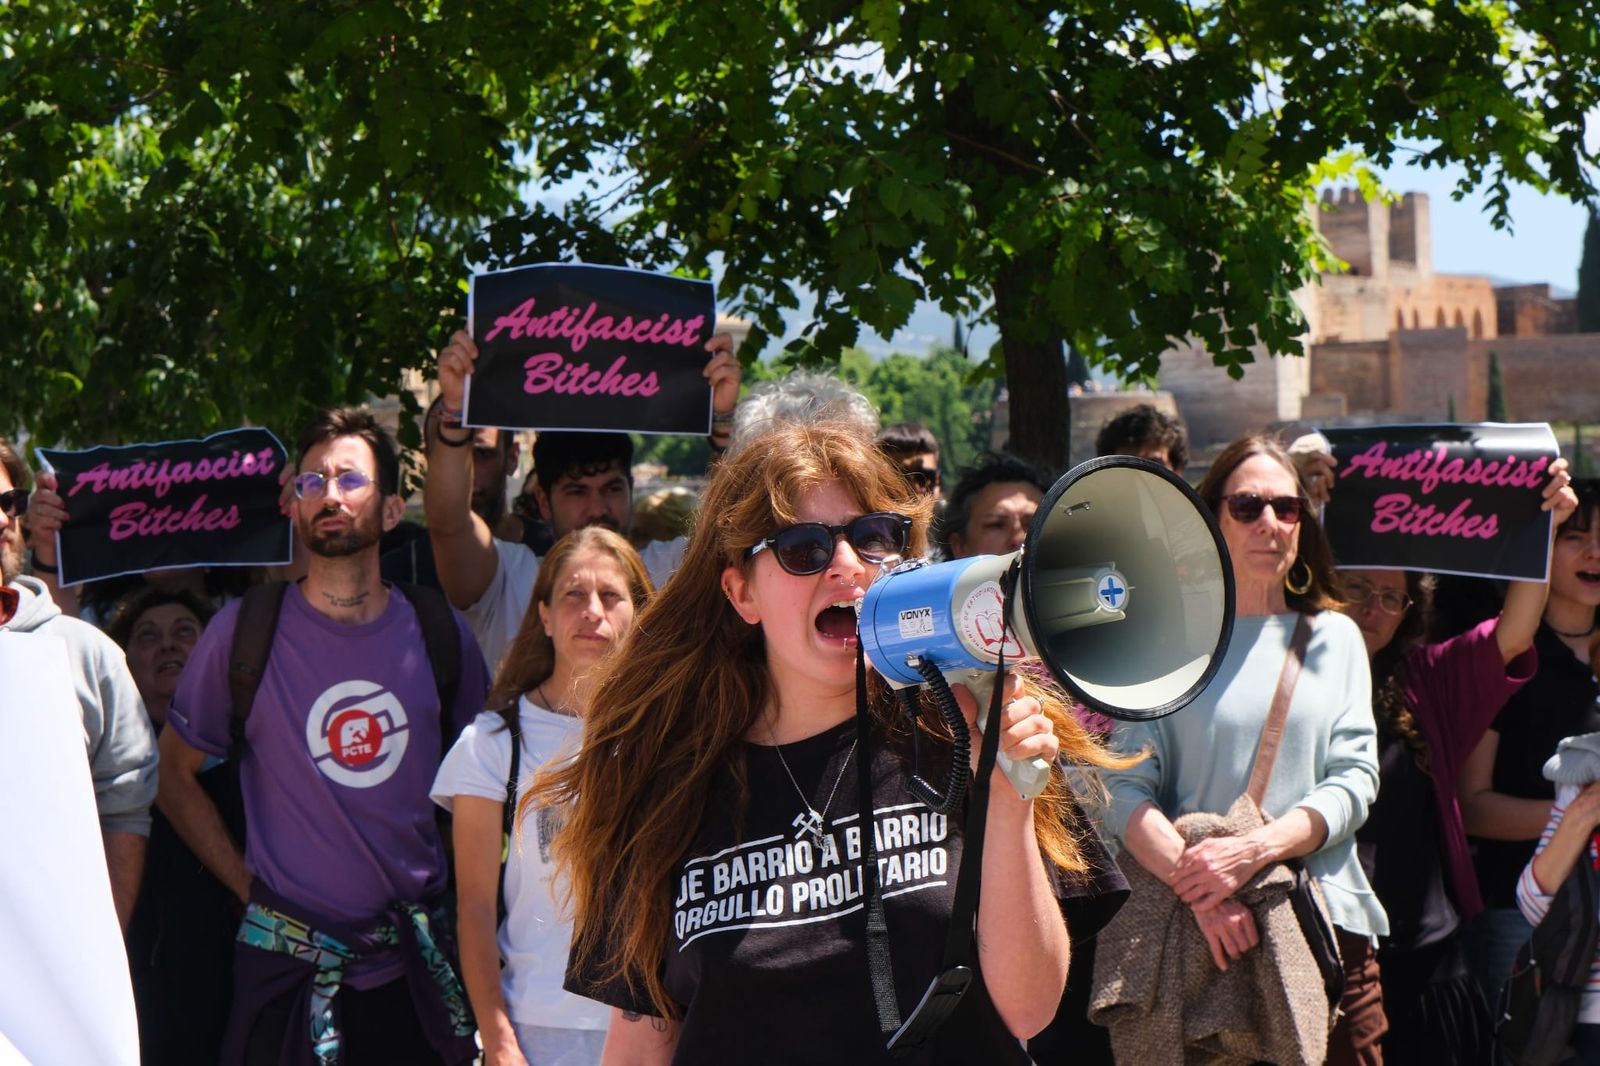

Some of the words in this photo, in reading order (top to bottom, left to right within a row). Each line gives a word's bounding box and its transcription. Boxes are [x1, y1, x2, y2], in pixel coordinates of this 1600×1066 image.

[485, 298, 704, 352] Antifascist
[523, 352, 660, 397] Bitches
[68, 447, 275, 498] Antifascist
[1340, 440, 1548, 494] Antifascist
[108, 494, 240, 540] Bitches
[1370, 493, 1498, 539] Bitches
[900, 609, 930, 620] VONYX
[342, 744, 372, 757] PCTE
[713, 840, 813, 895] BARRIO
[821, 833, 840, 868] A
[675, 884, 784, 940] ORGULLO
